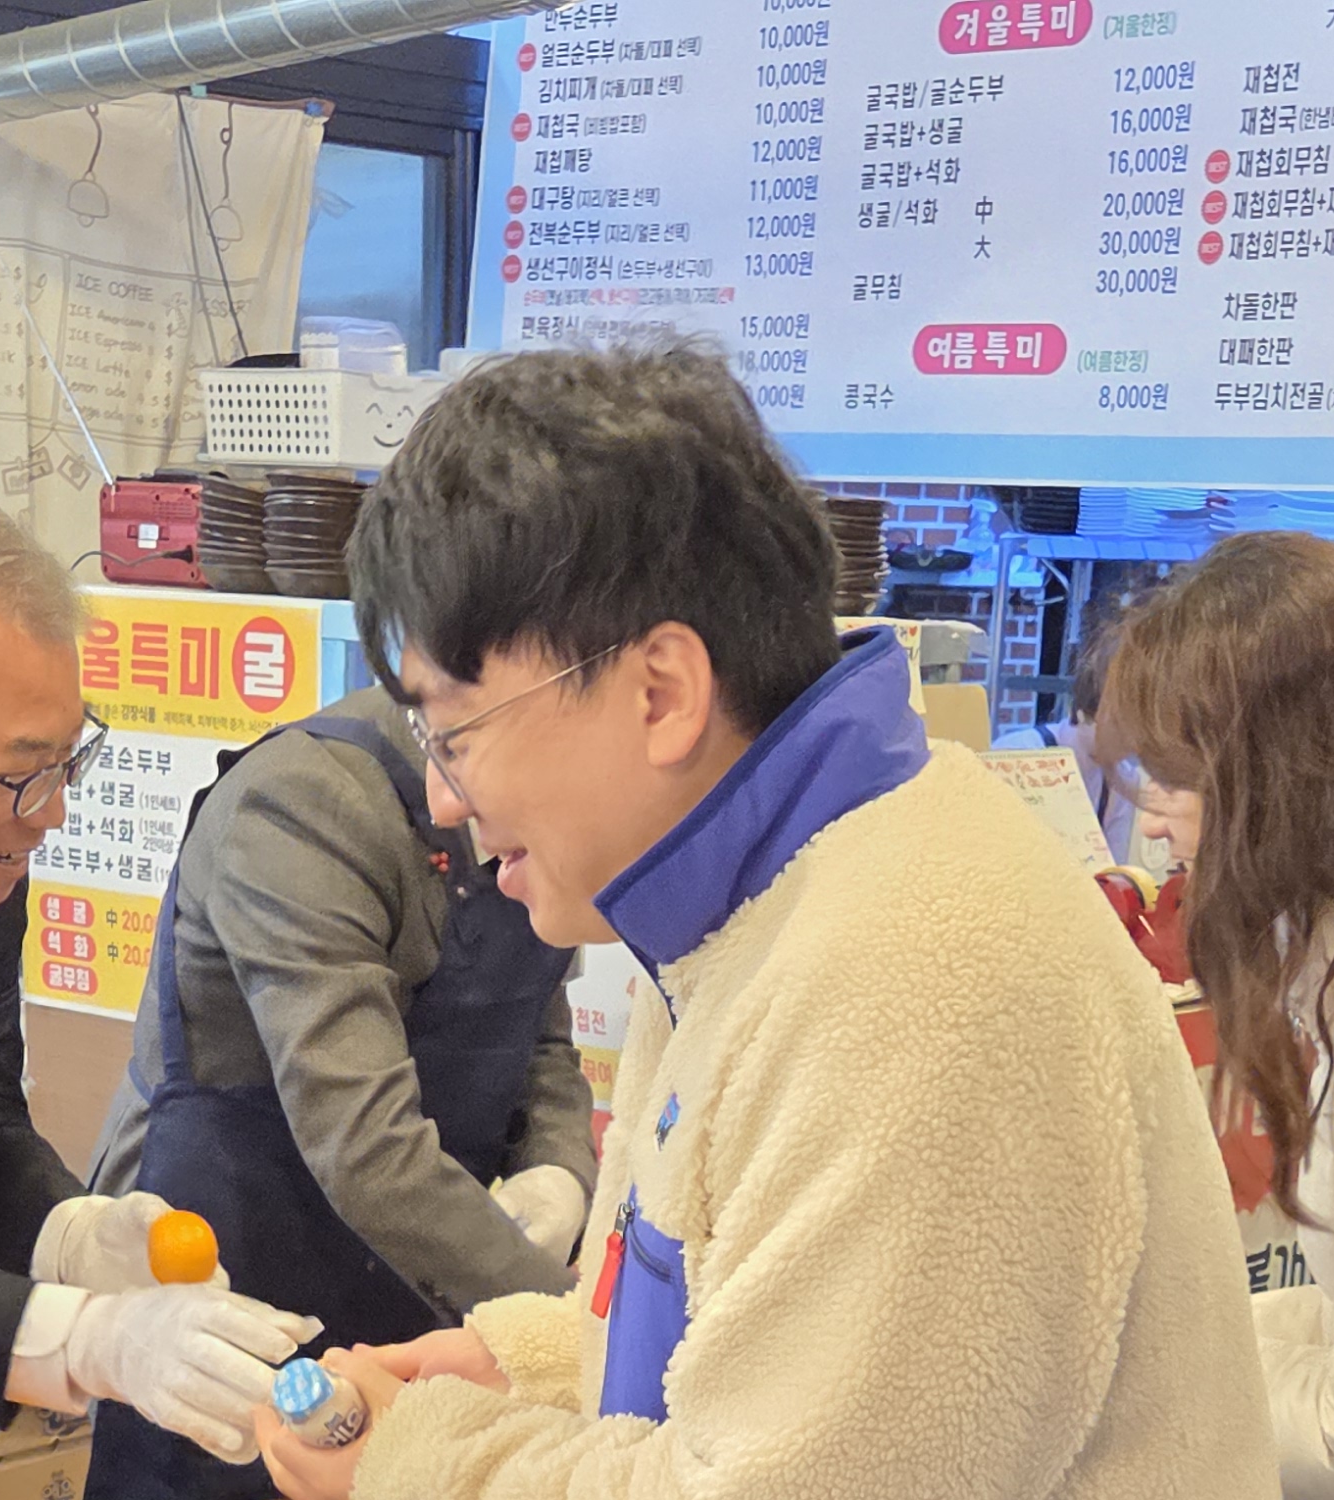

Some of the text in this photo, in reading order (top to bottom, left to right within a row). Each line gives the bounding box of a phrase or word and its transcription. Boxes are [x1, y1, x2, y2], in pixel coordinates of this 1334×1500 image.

[954, 4, 1177, 46] 겨울특미 (겨울한정)
[542, 38, 615, 68] 얼큰순두부
[759, 20, 830, 49] 10,000원
[756, 59, 827, 88] 10,000원
[866, 61, 1196, 112] 굴국밥/굴순두부 12,000원
[1243, 62, 1300, 94] 재첩전
[536, 113, 580, 139] 재첩국
[754, 97, 825, 127] 10,000원
[863, 103, 1192, 150] 굴국밥+생굴 16,000원
[1239, 105, 1297, 136] 재첩국
[751, 136, 822, 165] 12,000원
[1235, 145, 1331, 178] 재첩회무침
[860, 144, 1188, 190] 굴국밥+석화 16,000원
[531, 186, 575, 211] 대구탕
[749, 175, 819, 204] 11,000원
[858, 188, 1185, 228] 생굴/석화 中 20,000원
[528, 219, 601, 246] 전복순두부
[746, 212, 816, 240] 12,000원
[973, 226, 1181, 259] 大 30,000원
[526, 255, 613, 282] 생선구이정식
[744, 251, 814, 278] 13,000원
[75, 273, 154, 302] ICE COFFEE
[852, 266, 1178, 301] 굴무침 30,000원
[68, 303, 94, 320] ICE
[1222, 292, 1298, 321] 차돌한판
[68, 328, 90, 343] ICE
[740, 313, 809, 340] 15,000원
[65, 354, 89, 371] ICE
[927, 331, 1149, 374] 여름특미 (여름한정)
[1219, 337, 1294, 366] 대패한판
[844, 383, 1168, 411] 콩국수 8,000원
[1214, 382, 1324, 411] 두부김치전골
[81, 619, 286, 699] 울특미 굴
